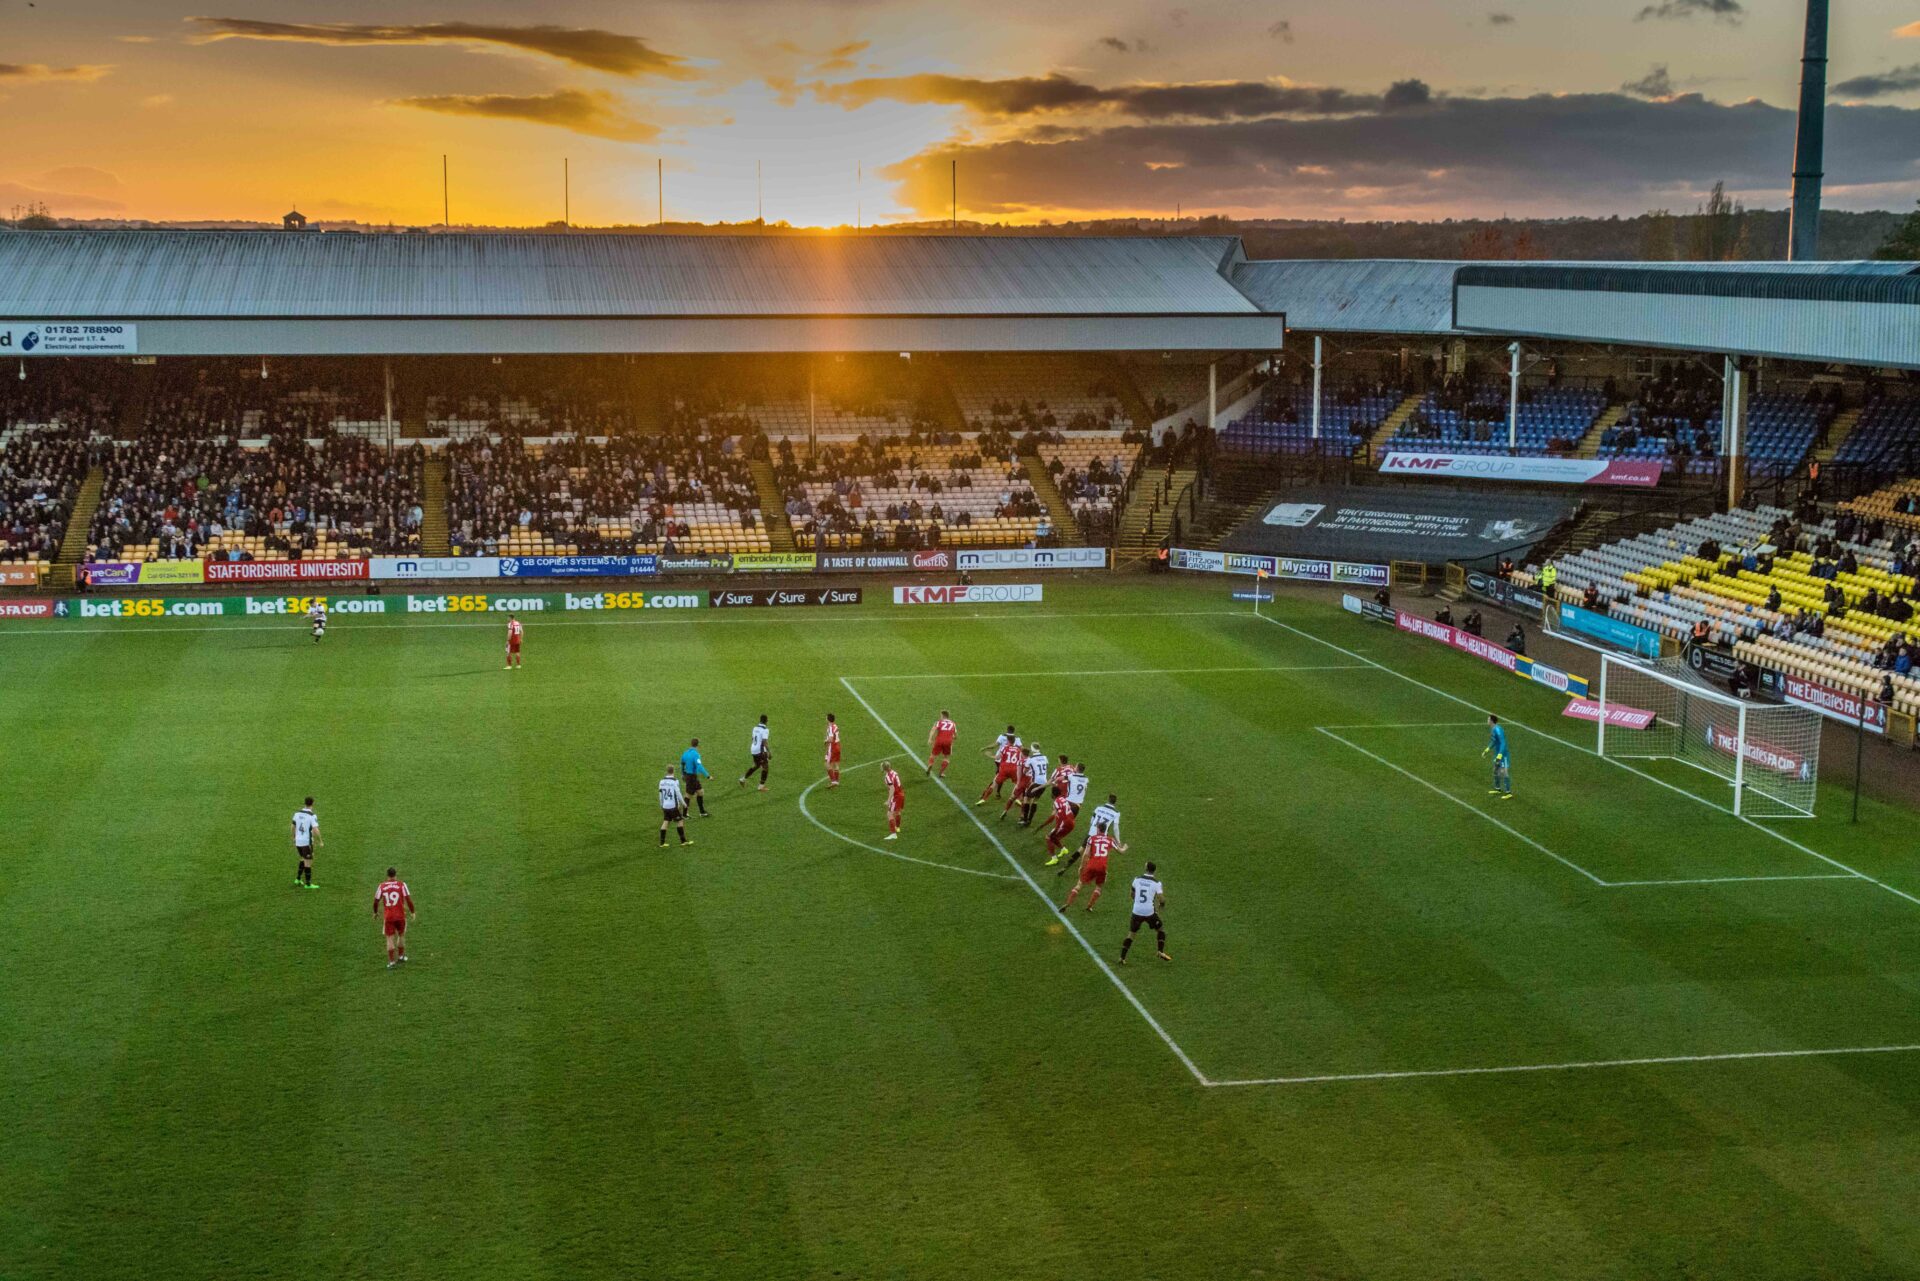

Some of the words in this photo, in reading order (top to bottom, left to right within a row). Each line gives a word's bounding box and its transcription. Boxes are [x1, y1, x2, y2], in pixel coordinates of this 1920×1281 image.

[45, 326, 80, 334] 01782
[84, 326, 123, 334] 788900
[738, 554, 783, 564] embroidery
[794, 554, 812, 564] print
[824, 558, 829, 567] A
[832, 558, 853, 567] TASTE
[855, 557, 865, 566] OF
[868, 556, 908, 566] CORNWALL
[1188, 557, 1222, 566] FITZJOHN
[1228, 556, 1272, 569] Intium
[88, 568, 127, 578] ureCare
[208, 564, 297, 579] STAFFORDSHIRE
[300, 562, 364, 577] UNIVERSITY
[1281, 560, 1328, 574] Mycroft
[1337, 565, 1385, 578] Fitzjohn
[565, 593, 698, 610] bet365.com
[726, 594, 752, 604] Sure
[779, 592, 805, 603] Sure
[831, 591, 856, 602] Sure
[22, 605, 47, 614] CUP
[80, 599, 223, 617] bet365.com
[246, 597, 384, 614] bet365.com
[408, 595, 544, 612] bet365.com
[1412, 618, 1423, 633] LIFE
[1423, 621, 1450, 642] INSURANCE
[1488, 643, 1516, 670] INSURANCE
[1787, 680, 1803, 697] THE
[1804, 683, 1844, 711] Emirates
[1845, 703, 1856, 715] FA
[941, 721, 954, 730] 27
[1006, 752, 1017, 764] 16
[1718, 734, 1732, 750] THE
[1768, 754, 1777, 768] FA
[1778, 756, 1795, 770] CUP
[1077, 784, 1084, 795] 9
[1095, 843, 1108, 857] 15
[382, 891, 400, 906] 19
[1140, 890, 1147, 903] 5
